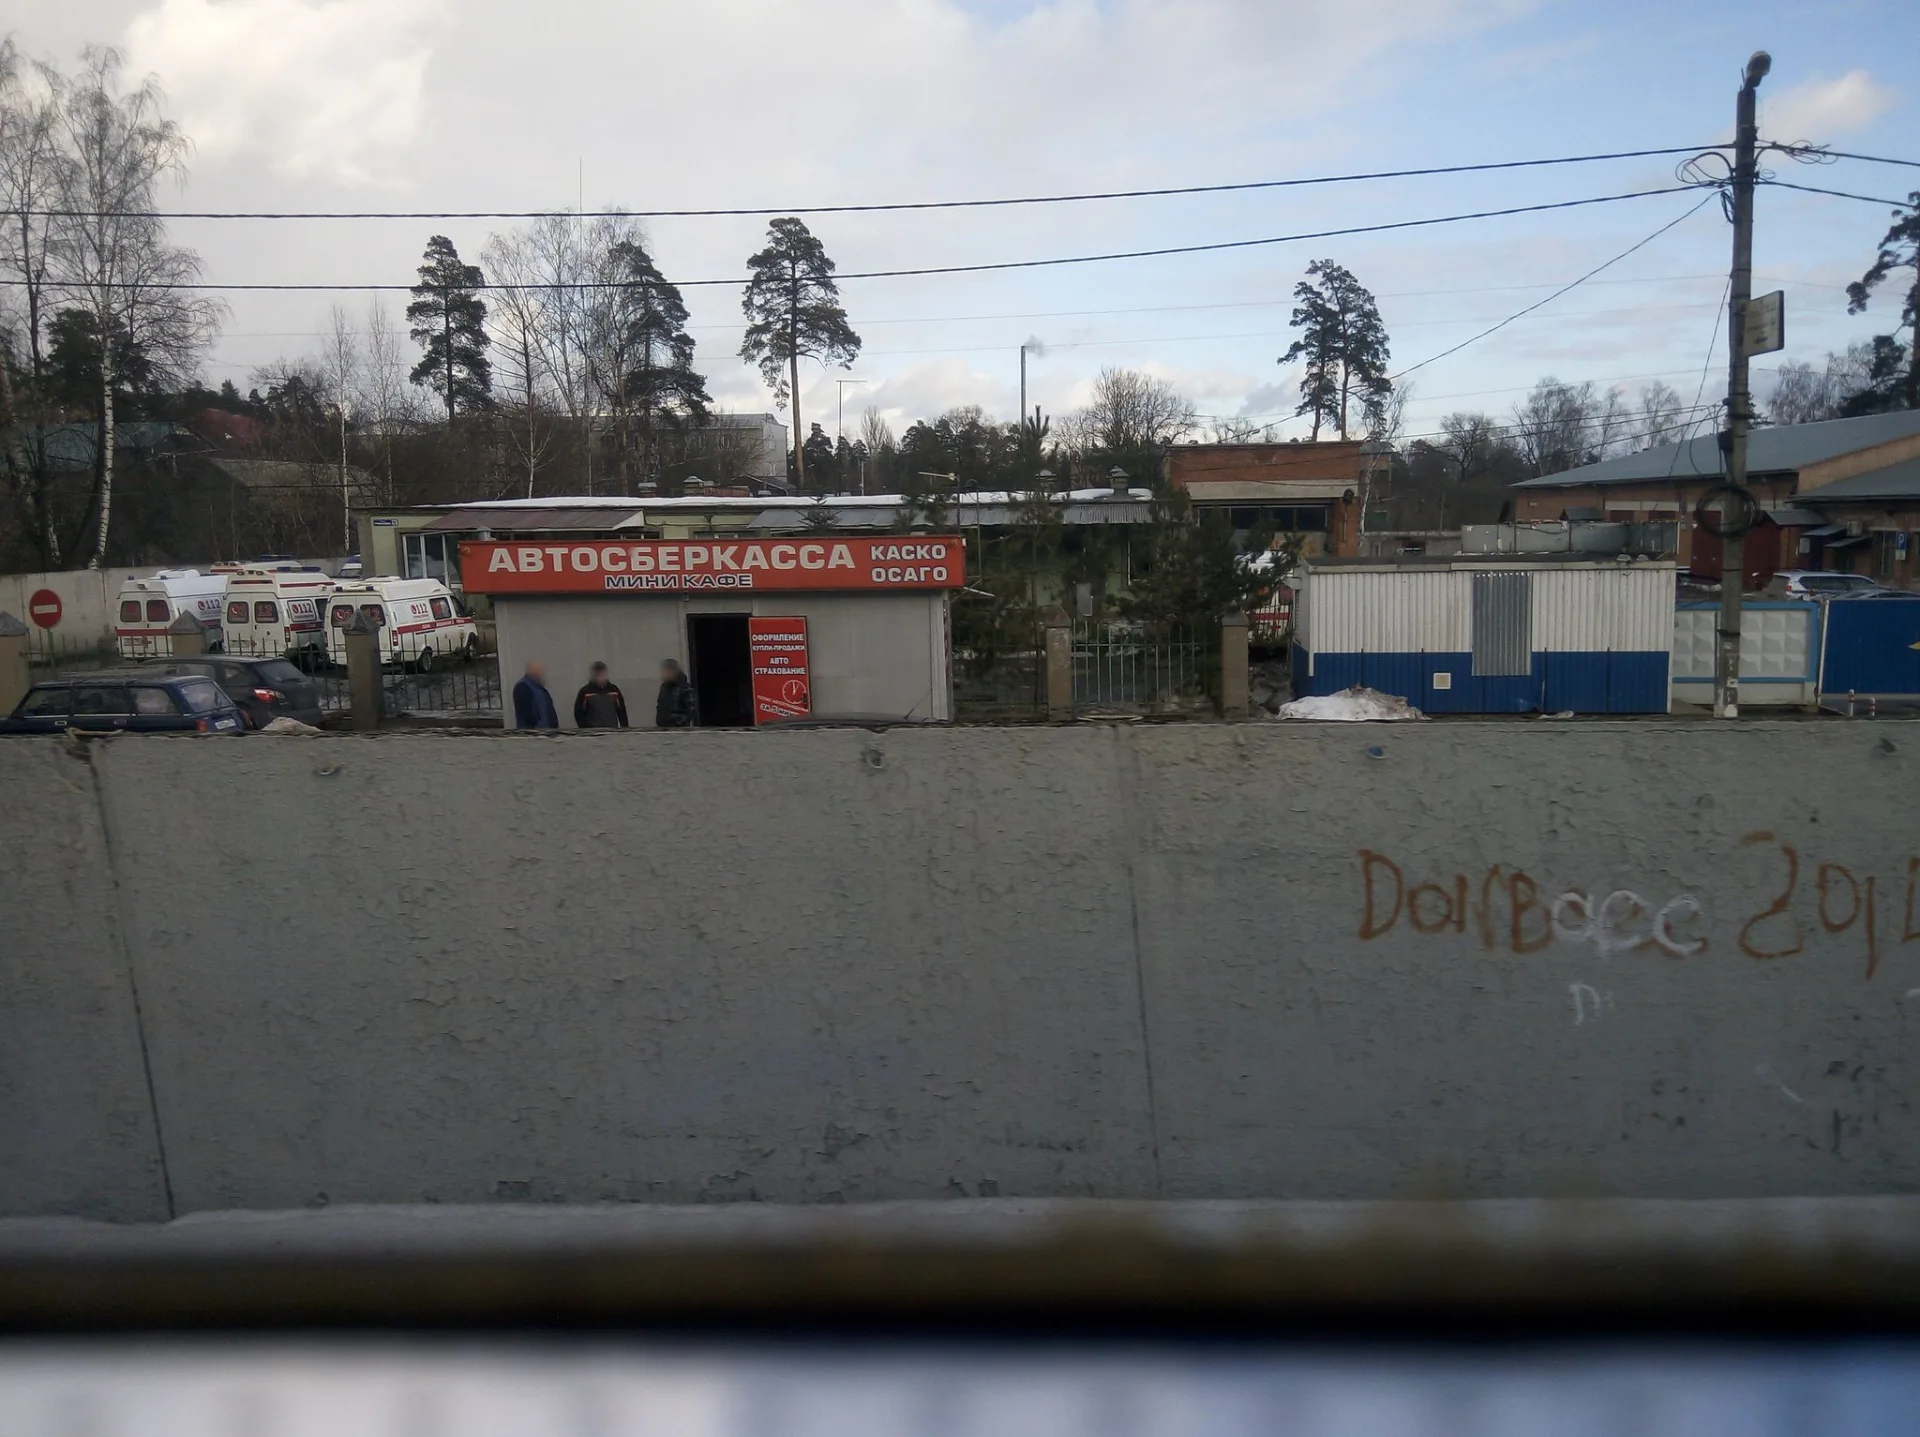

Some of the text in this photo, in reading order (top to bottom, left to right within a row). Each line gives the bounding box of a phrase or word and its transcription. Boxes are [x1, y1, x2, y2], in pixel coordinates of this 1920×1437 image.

[871, 544, 947, 561] КАСКО
[488, 544, 856, 573] АВТОСБЕРКАССА
[871, 566, 948, 583] ОСАГО
[605, 573, 753, 590] МИНИ КАФЕ
[206, 599, 222, 610] 112
[299, 603, 313, 614] 112
[415, 603, 429, 615] 112
[752, 633, 804, 641] ОФОРМЛЕНИЕ
[769, 657, 789, 665] АВТО
[754, 667, 806, 675] СТРАХОВАНИЕ
